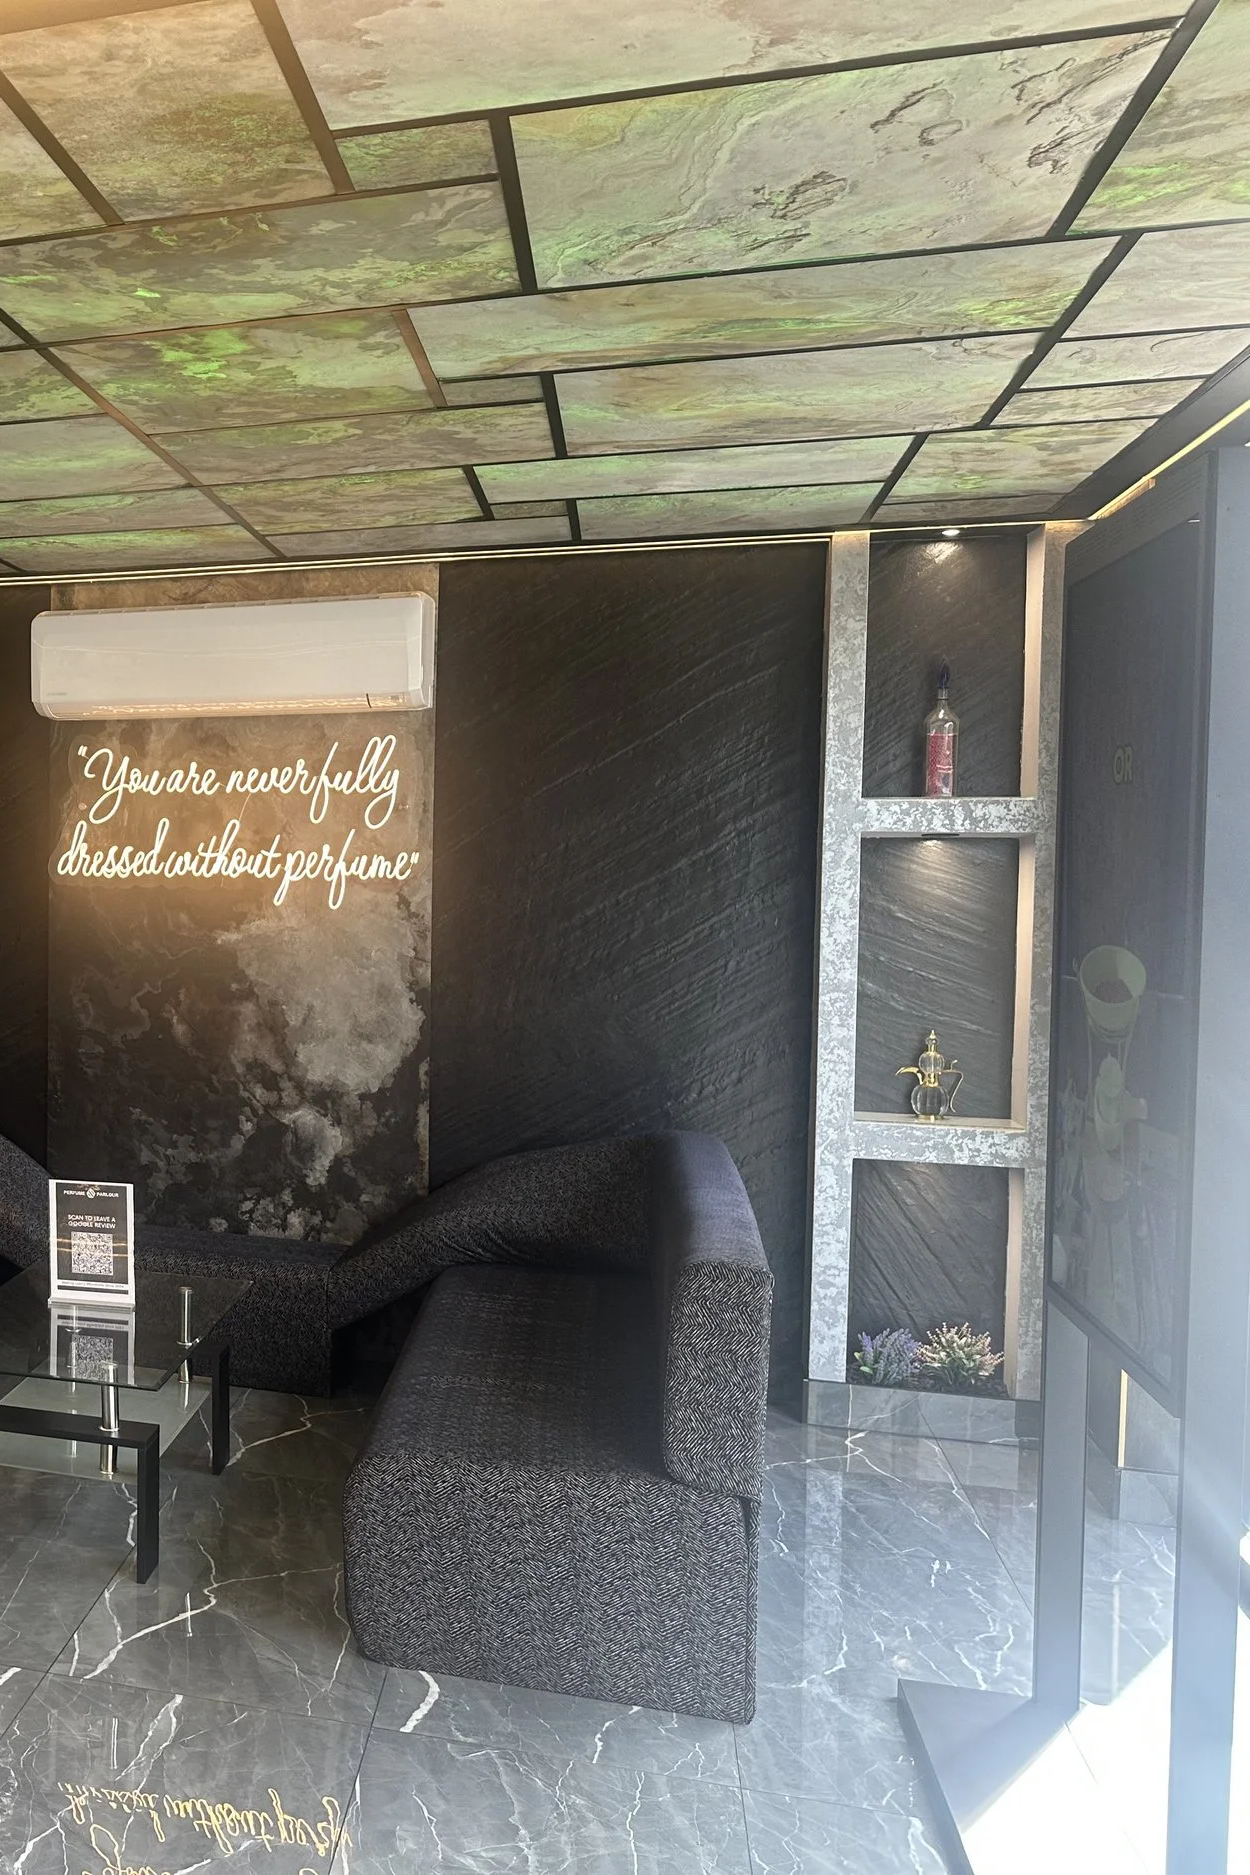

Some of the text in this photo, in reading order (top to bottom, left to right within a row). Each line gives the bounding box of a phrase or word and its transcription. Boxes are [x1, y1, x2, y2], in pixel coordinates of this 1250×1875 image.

[166, 761, 220, 795] are
[225, 758, 312, 795] never
[310, 734, 400, 830] fully
[57, 817, 166, 878] dressed
[164, 818, 282, 879] without
[67, 1220, 93, 1228] GOOGLE
